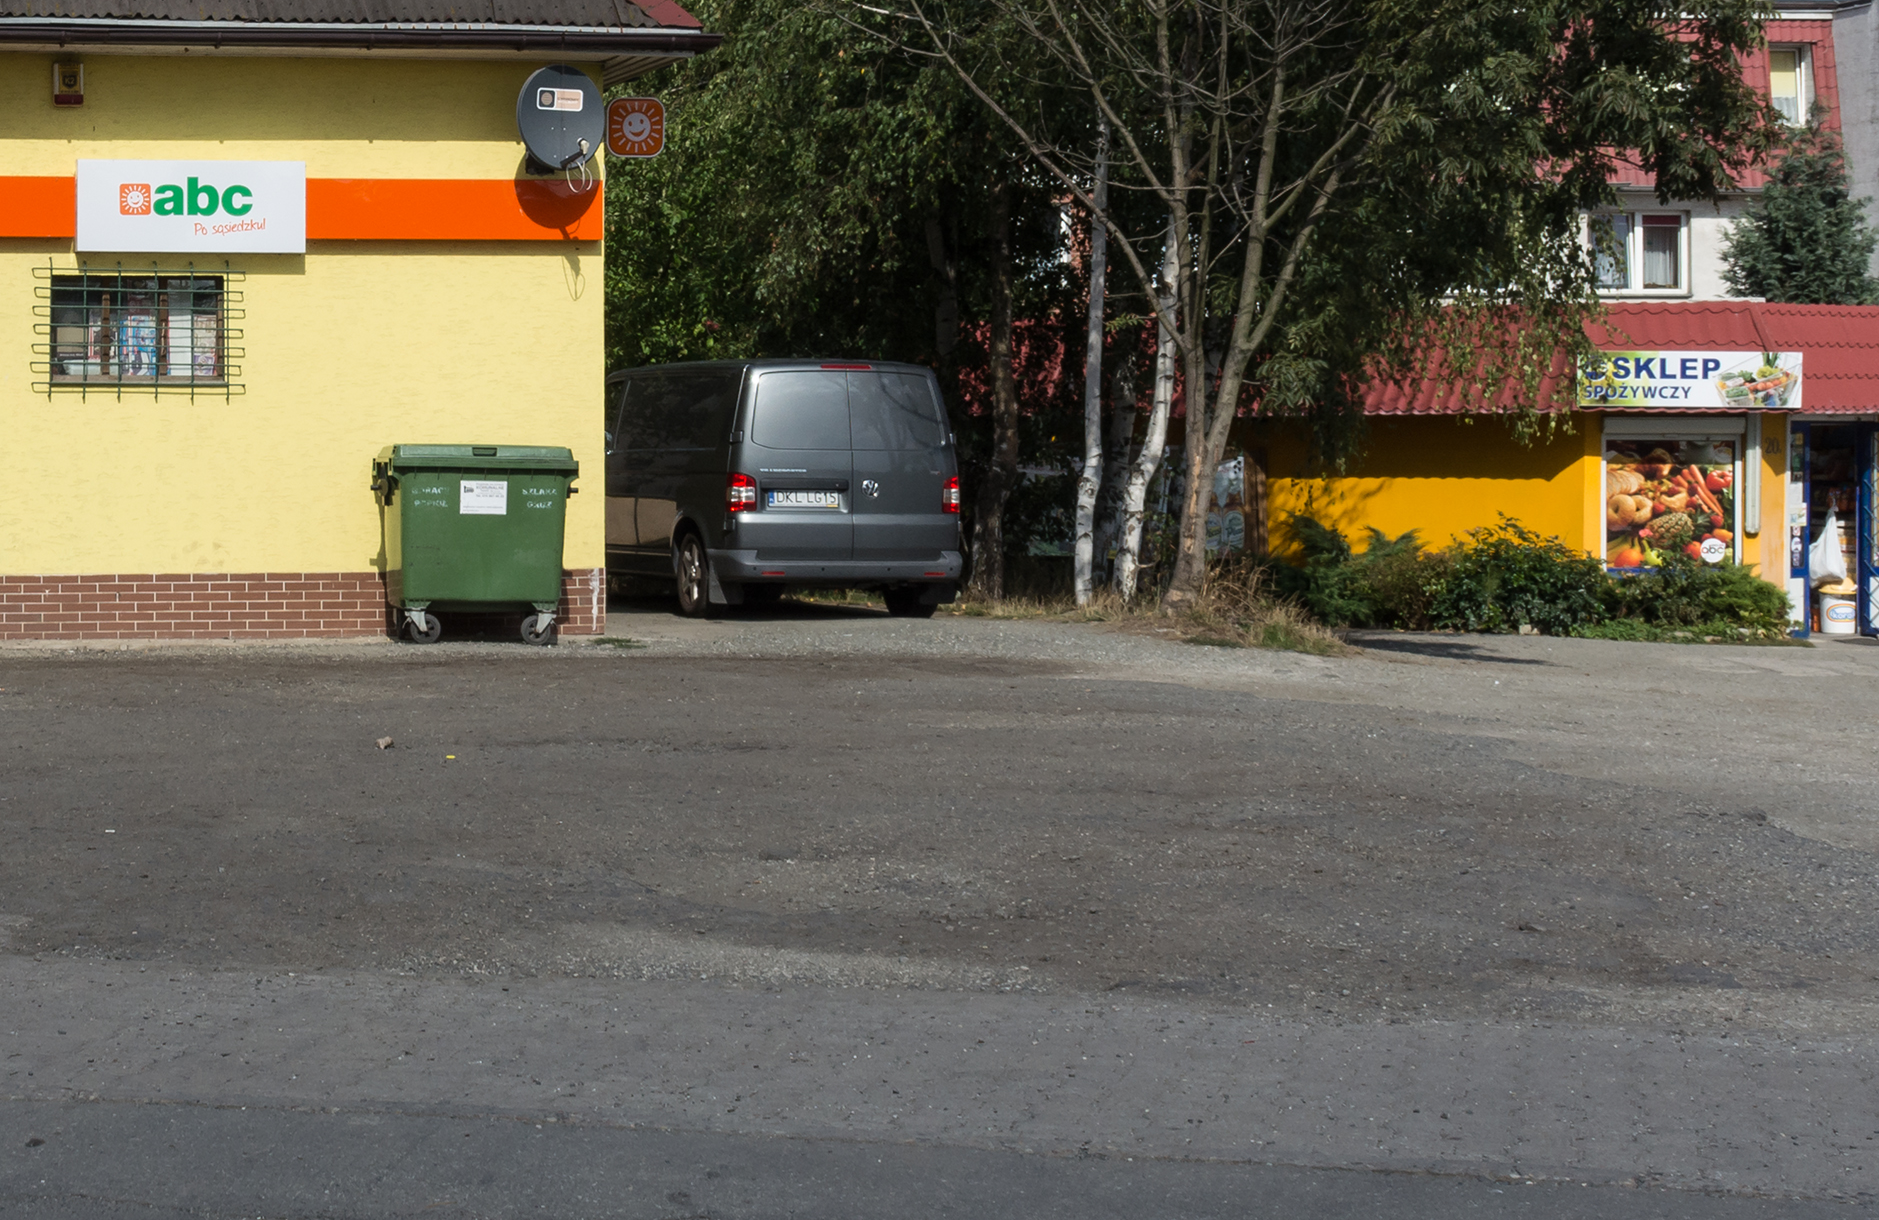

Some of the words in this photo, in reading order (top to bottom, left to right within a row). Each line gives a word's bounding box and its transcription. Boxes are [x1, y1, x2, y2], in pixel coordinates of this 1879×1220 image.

[153, 177, 253, 216] abc
[194, 222, 208, 235] Po
[212, 218, 266, 236] sąsiedzku!
[1612, 357, 1721, 380] SKLEP
[1584, 382, 1692, 399] SPOŻYWCZY
[776, 491, 802, 503] DKL
[807, 491, 837, 503] LG15
[1701, 544, 1724, 554] abc
